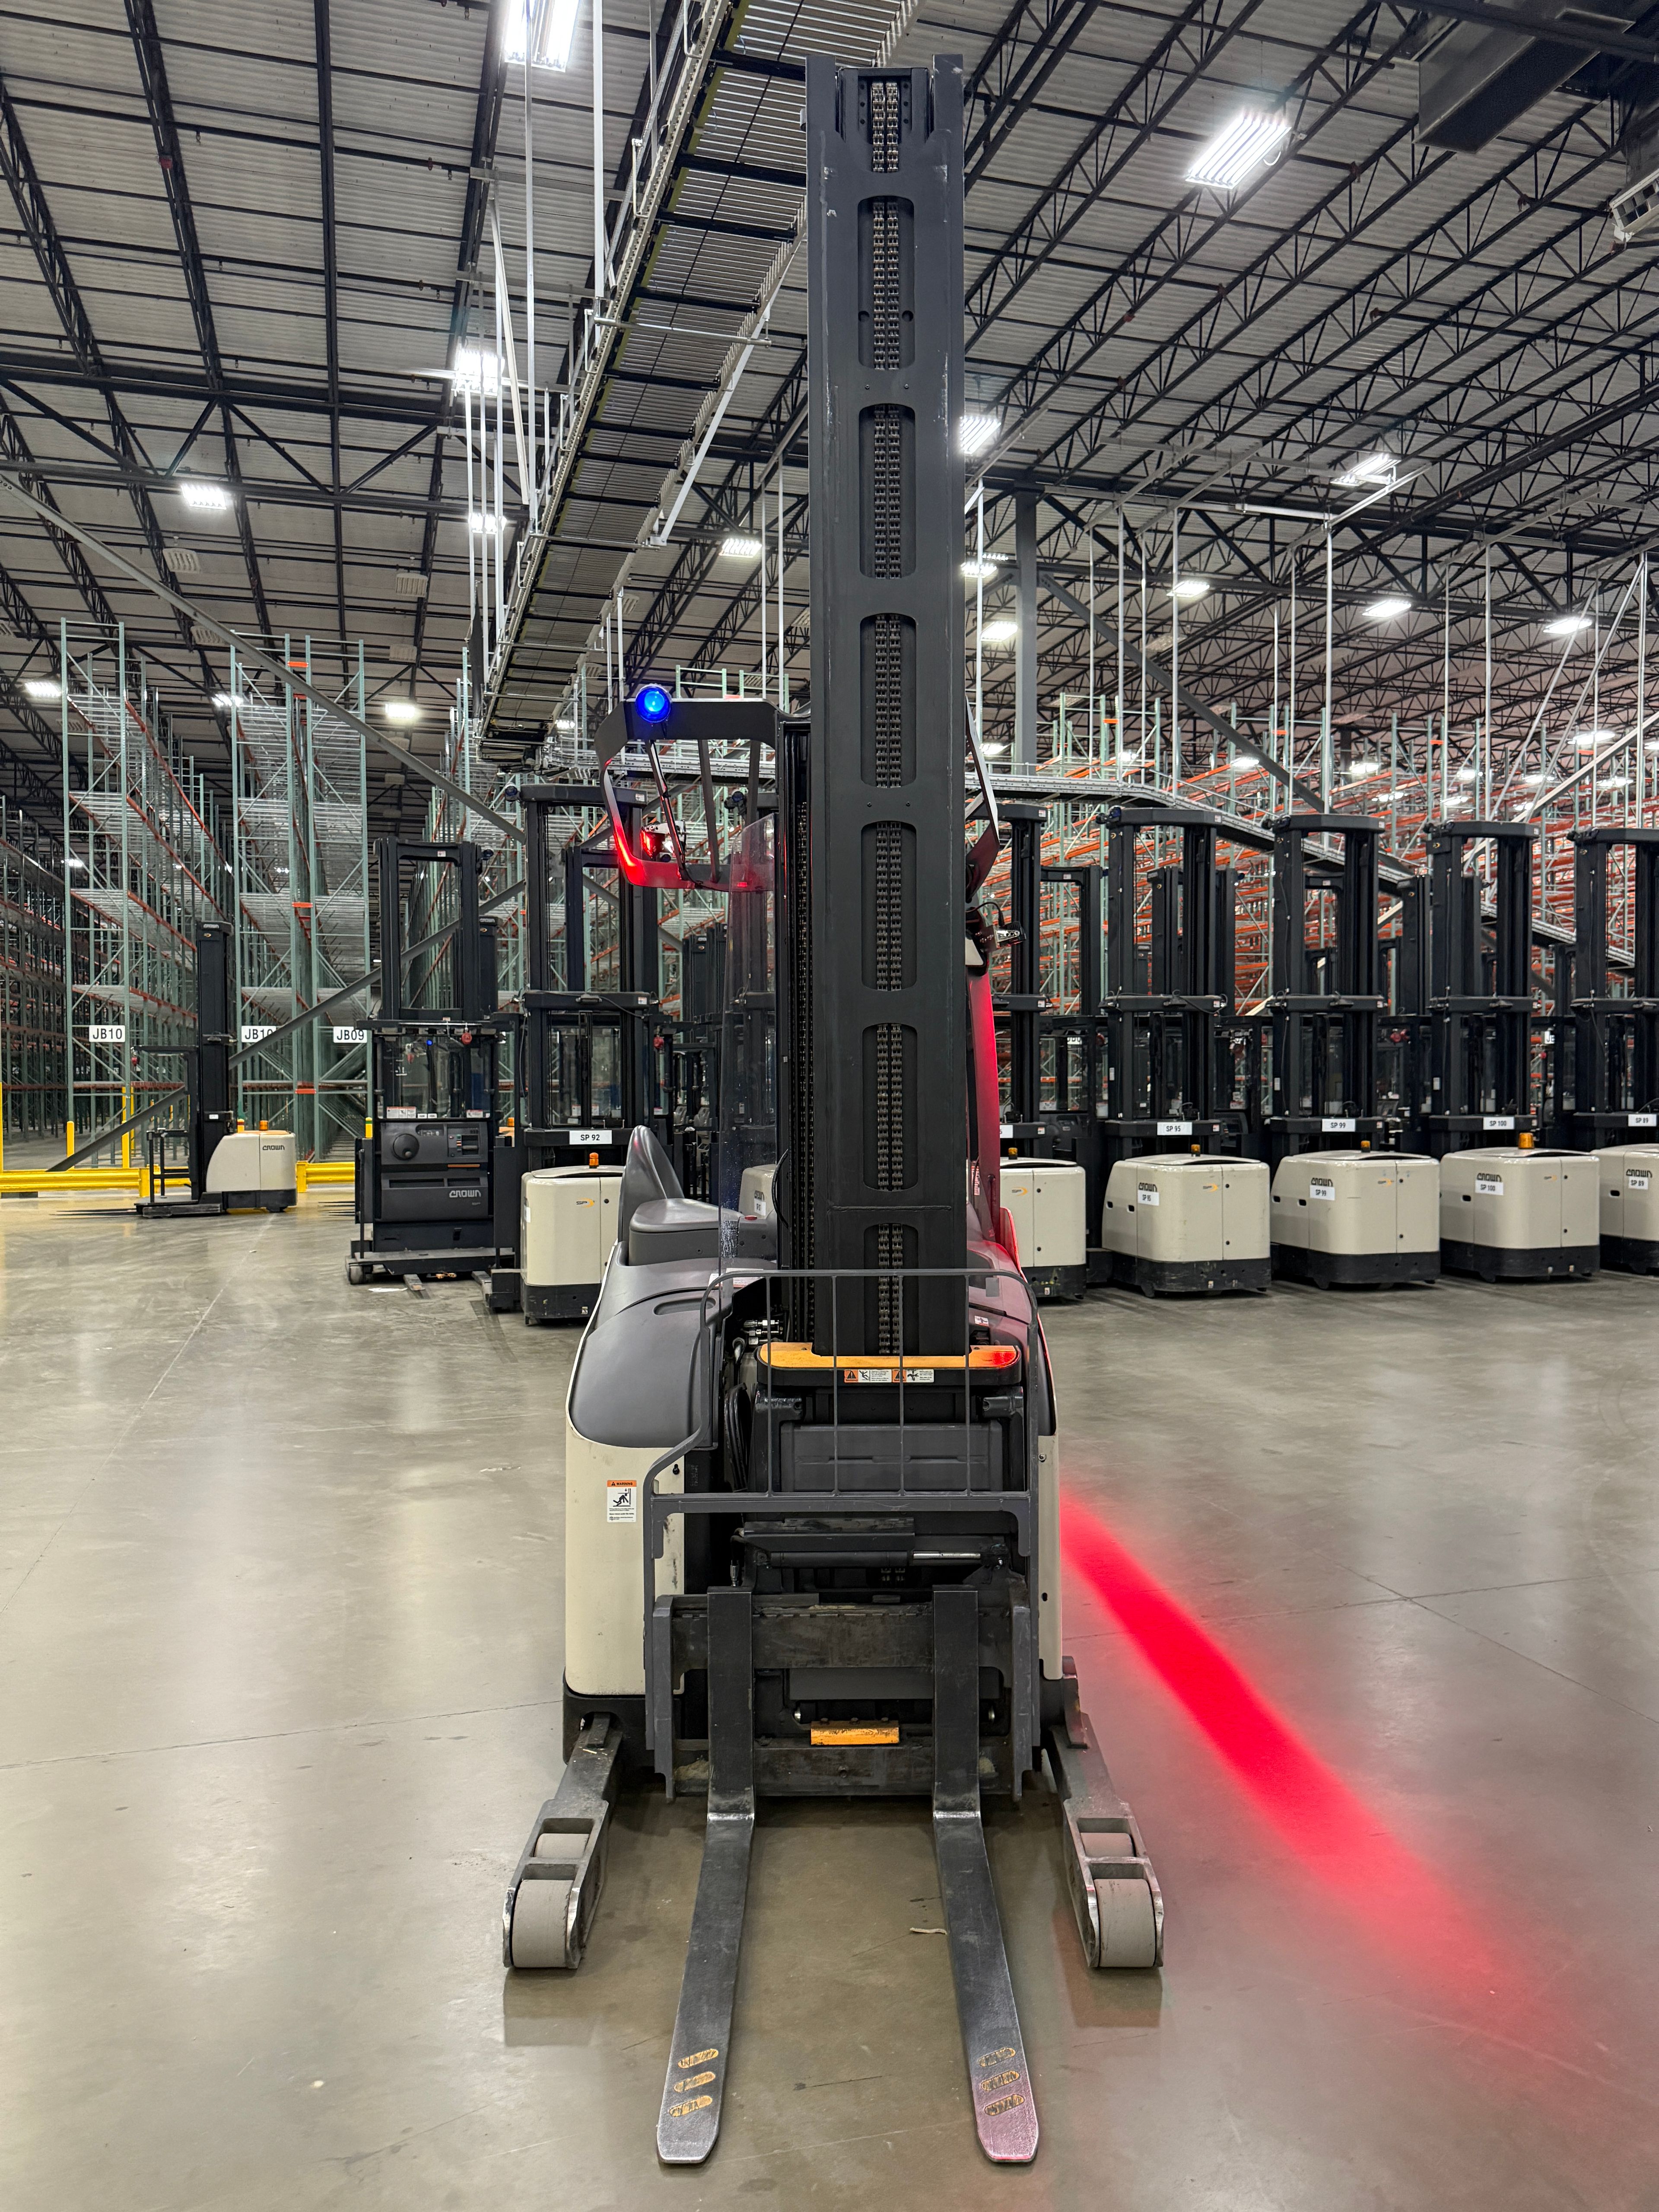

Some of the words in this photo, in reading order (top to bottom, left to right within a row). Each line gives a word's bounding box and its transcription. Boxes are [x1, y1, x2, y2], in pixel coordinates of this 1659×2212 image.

[93, 1028, 122, 1039] JB10
[337, 1030, 364, 1040] JB09
[1477, 1173, 1502, 1182] CROWN
[1626, 1169, 1653, 1178] CROWN
[1311, 1178, 1333, 1187] CROWN
